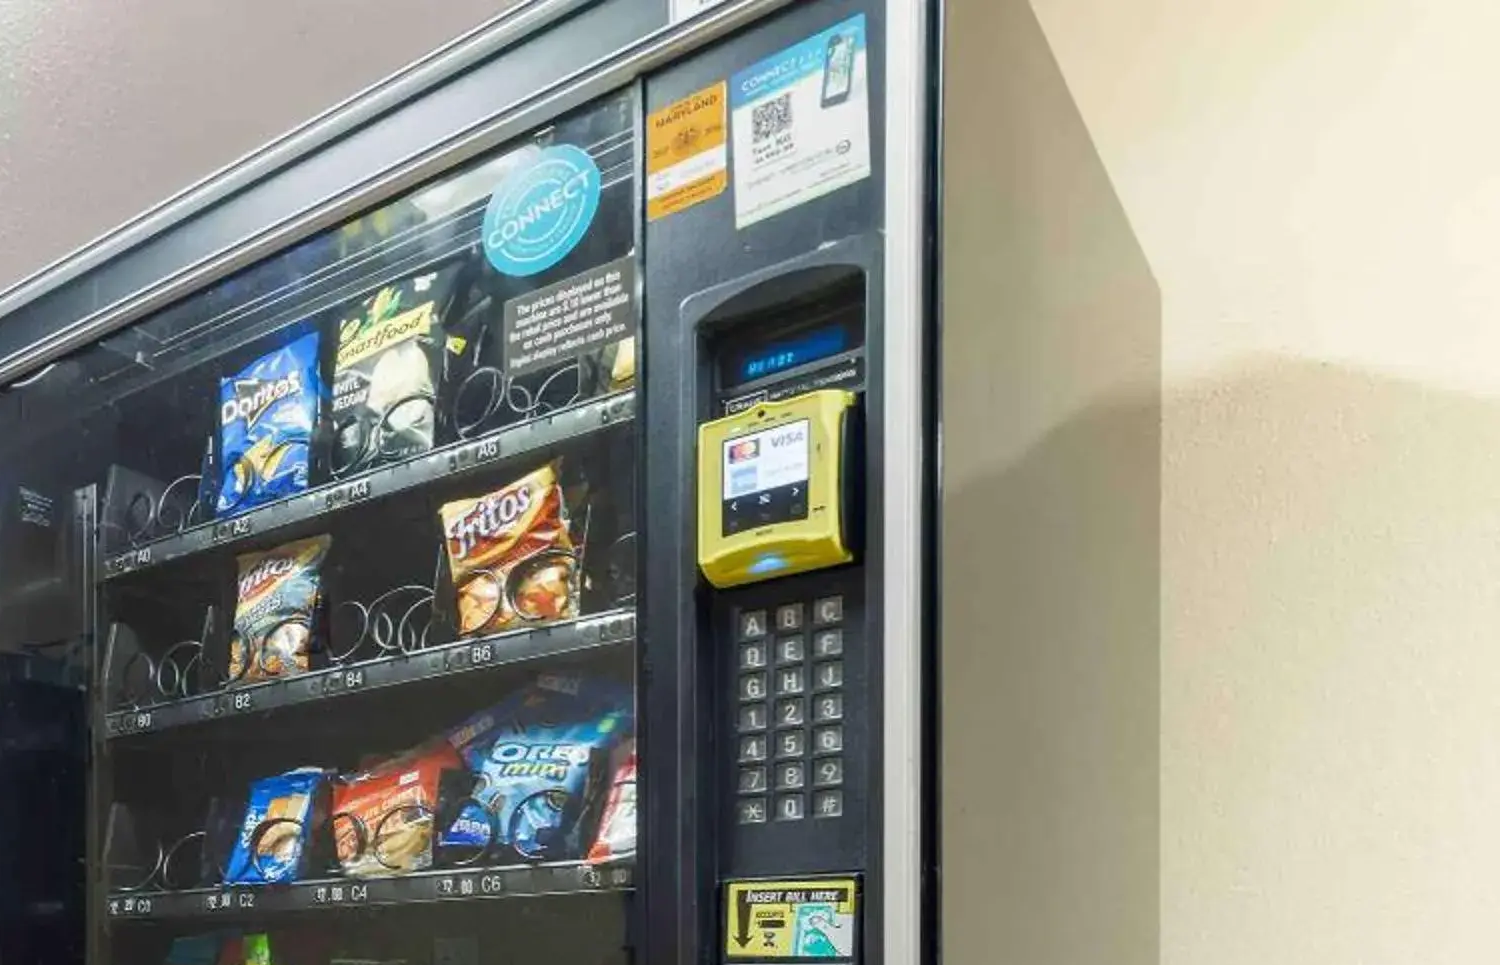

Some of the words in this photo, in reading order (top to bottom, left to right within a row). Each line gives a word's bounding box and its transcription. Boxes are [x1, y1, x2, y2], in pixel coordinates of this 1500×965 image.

[488, 168, 591, 249] CONNECT
[221, 371, 301, 425] Doritos
[770, 429, 805, 449] VISA
[350, 481, 369, 498] A4
[232, 517, 250, 534] A2
[446, 485, 531, 560] Fritos
[783, 673, 797, 691] H
[491, 742, 590, 766] OREO
[503, 761, 567, 780] mini
[351, 885, 368, 899] C4
[481, 875, 501, 893] C6
[239, 893, 254, 908] C2
[745, 889, 782, 903] INSERT
[785, 890, 808, 903] BILL
[810, 890, 840, 902] HERE
